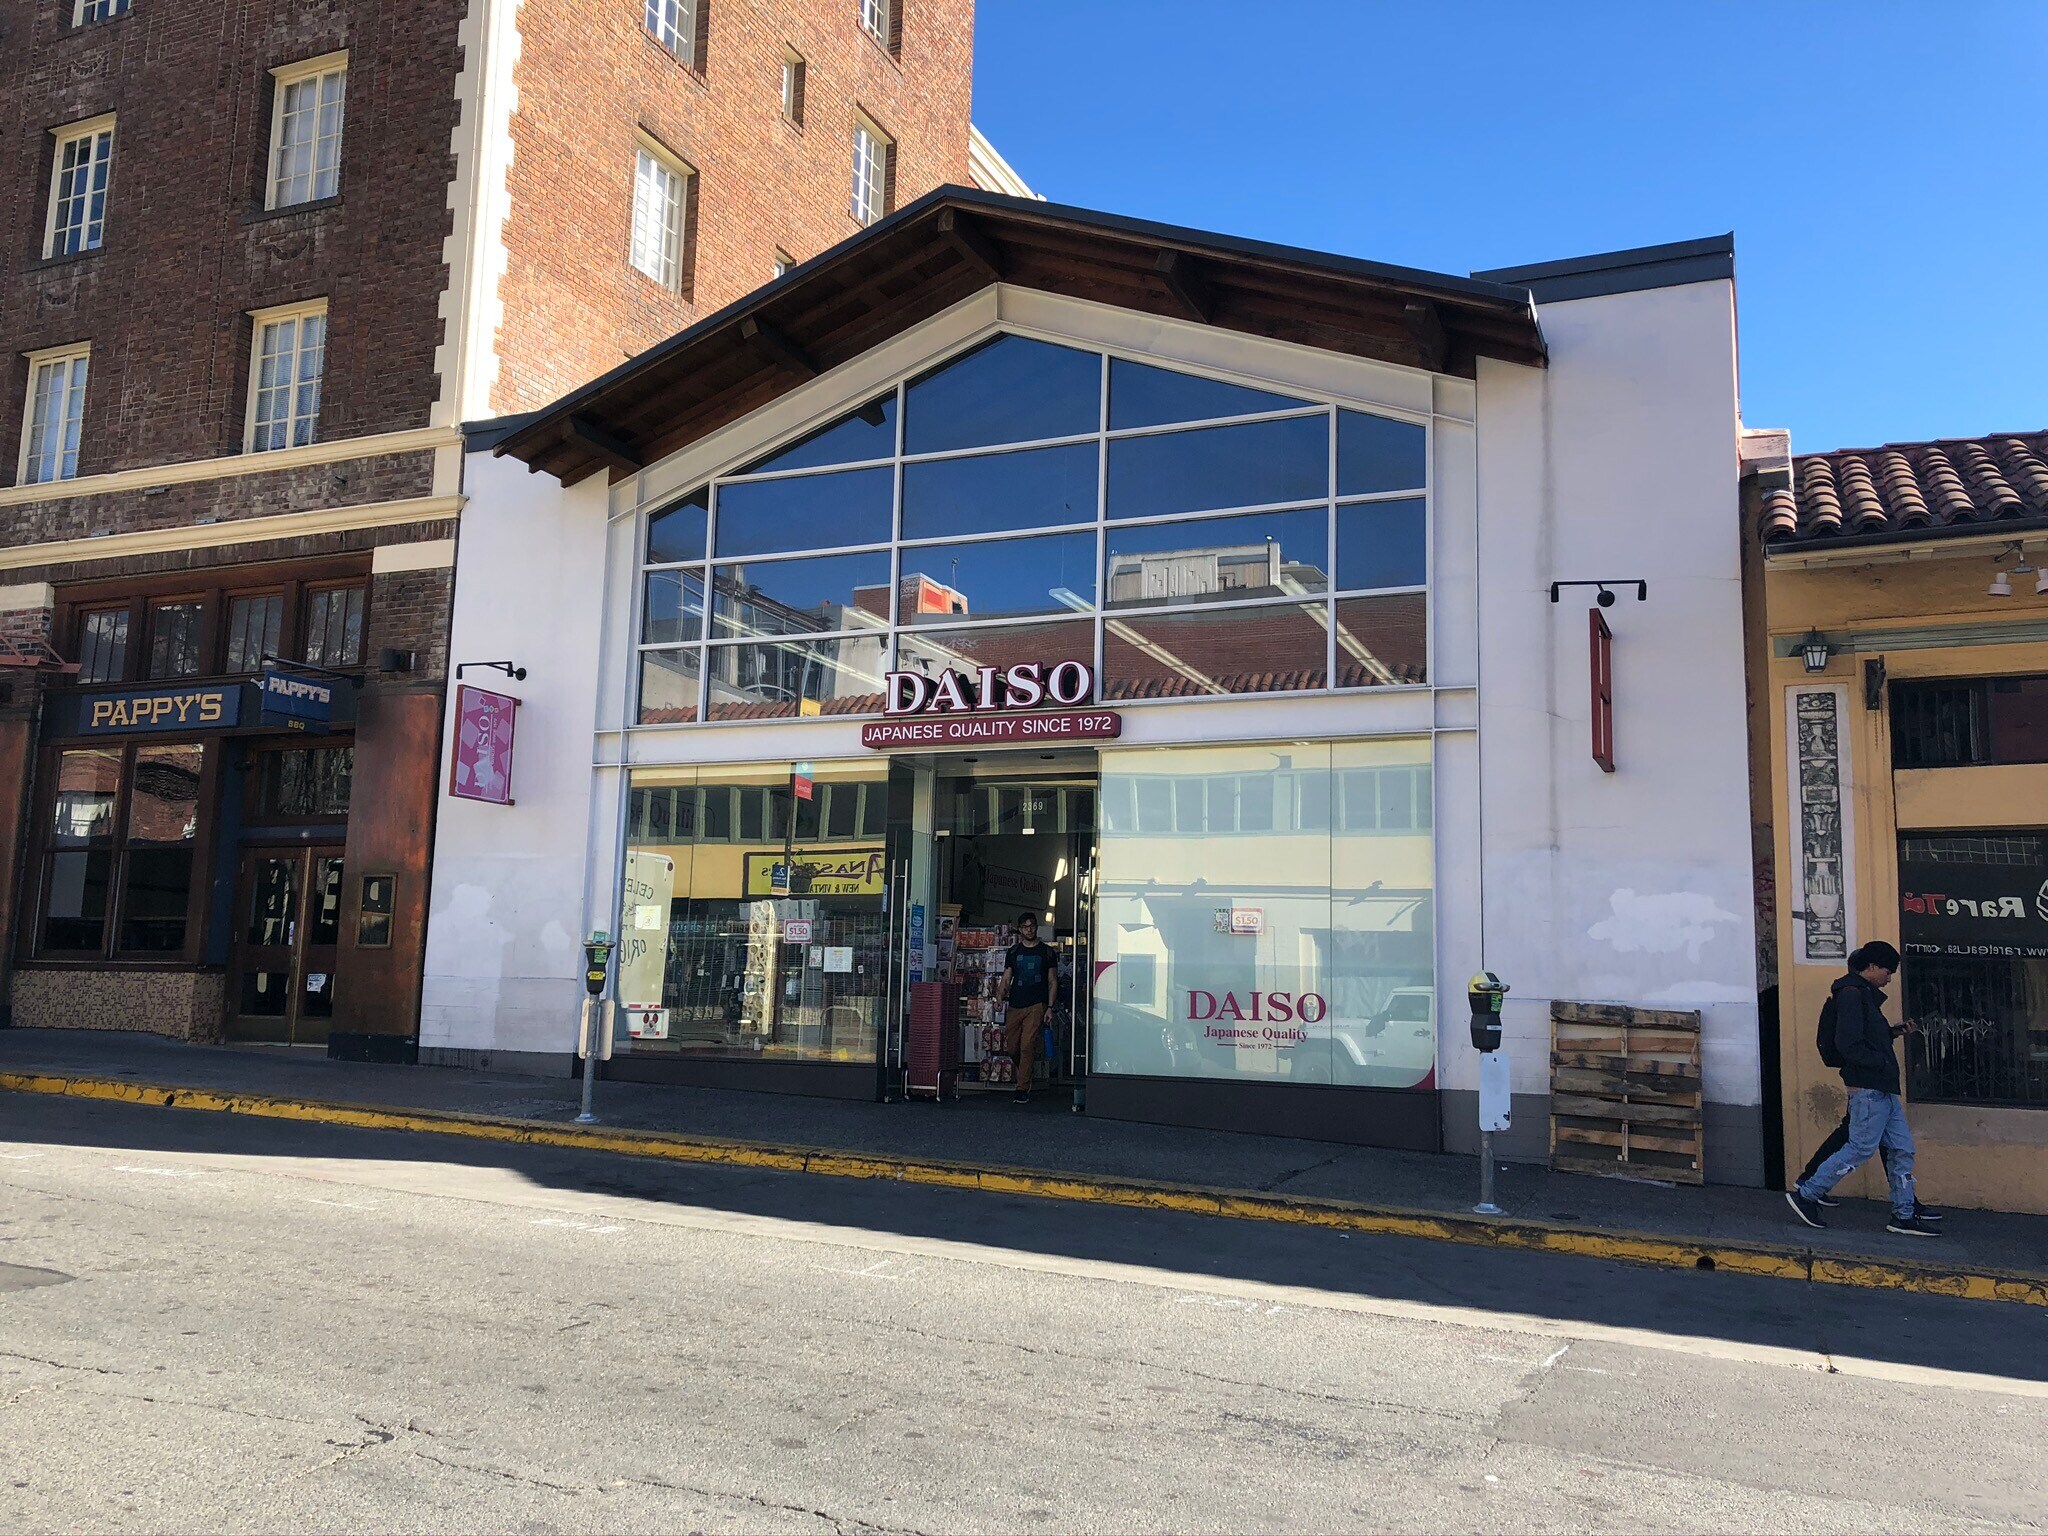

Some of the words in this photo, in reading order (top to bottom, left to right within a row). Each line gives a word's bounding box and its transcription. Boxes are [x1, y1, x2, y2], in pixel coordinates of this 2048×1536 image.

[268, 676, 331, 704] PAPPY'S
[884, 660, 1094, 717] DAISO
[91, 693, 222, 727] PAPPY'S
[287, 720, 305, 731] BBQ
[864, 725, 943, 742] JAPANESE
[949, 721, 1016, 738] QUALITY
[1022, 718, 1071, 734] SINCE
[1077, 716, 1112, 731] 1972
[1022, 801, 1044, 812] 2369
[1235, 916, 1258, 925] $1.50
[789, 927, 807, 935] $1.50
[1187, 990, 1327, 1023] DAISO
[1203, 1025, 1259, 1040] Japanese
[1262, 1027, 1308, 1042] Quality
[1238, 1042, 1256, 1050] Since
[1257, 1042, 1272, 1050] 1972
